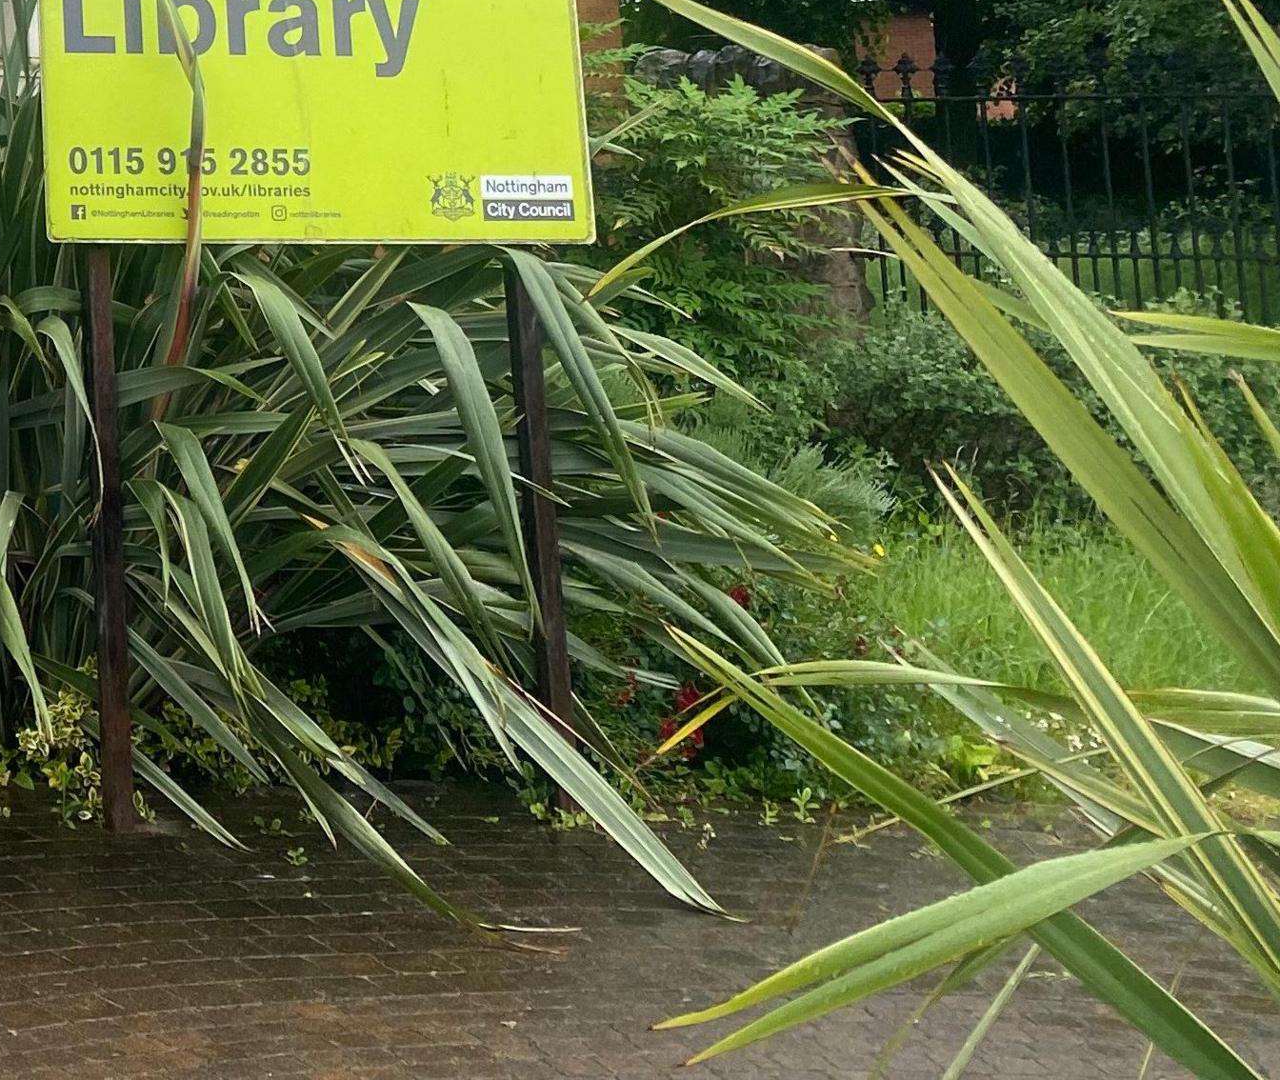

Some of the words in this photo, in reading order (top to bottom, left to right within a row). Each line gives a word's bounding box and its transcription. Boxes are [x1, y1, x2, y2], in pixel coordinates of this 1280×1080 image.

[69, 146, 145, 175] 0115
[229, 148, 310, 176] 2855
[70, 182, 311, 199] nottinghamcity.ov.uk/libraries
[486, 179, 568, 196] Nottingham
[486, 202, 515, 219] City
[518, 201, 571, 217] Council
